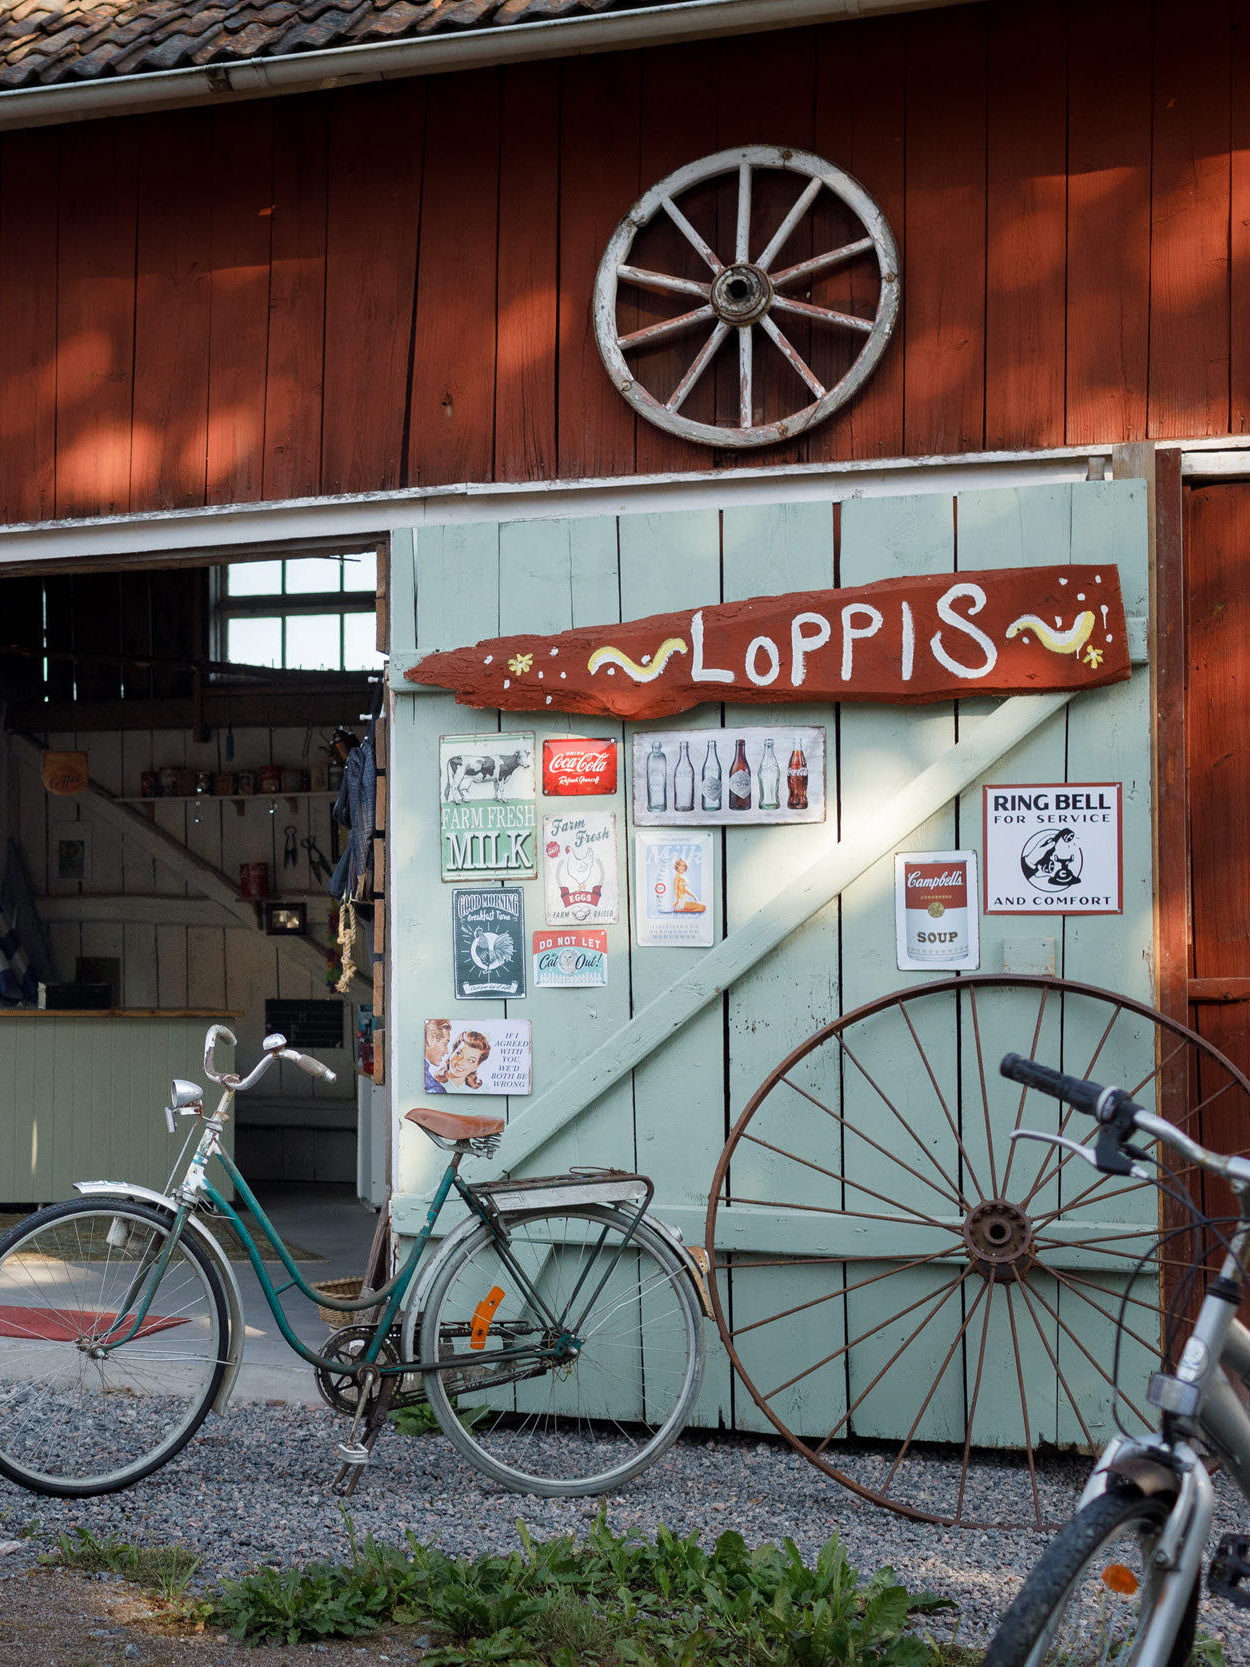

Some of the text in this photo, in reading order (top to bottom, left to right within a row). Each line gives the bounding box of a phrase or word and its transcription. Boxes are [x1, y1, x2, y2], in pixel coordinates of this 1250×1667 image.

[549, 752, 610, 773] Coca-Cola
[993, 793, 1111, 811] RING BELL
[442, 804, 535, 829] FARM FRESH
[994, 814, 1110, 824] FOR SERVICE
[551, 818, 585, 836] Farm
[574, 826, 610, 848] Fresh
[446, 830, 534, 871] MILK
[646, 845, 703, 865] Milk
[907, 871, 963, 890] Campbell's
[457, 893, 519, 919] GOOD MORNING
[569, 893, 592, 903] EGGS
[993, 896, 1111, 905] AND COMFORT
[467, 909, 511, 921] Breakfast Time
[593, 910, 613, 918] RAISED
[539, 936, 601, 950] DO NOT LET
[916, 931, 958, 943] SOUP
[539, 953, 602, 971] Cat Out!
